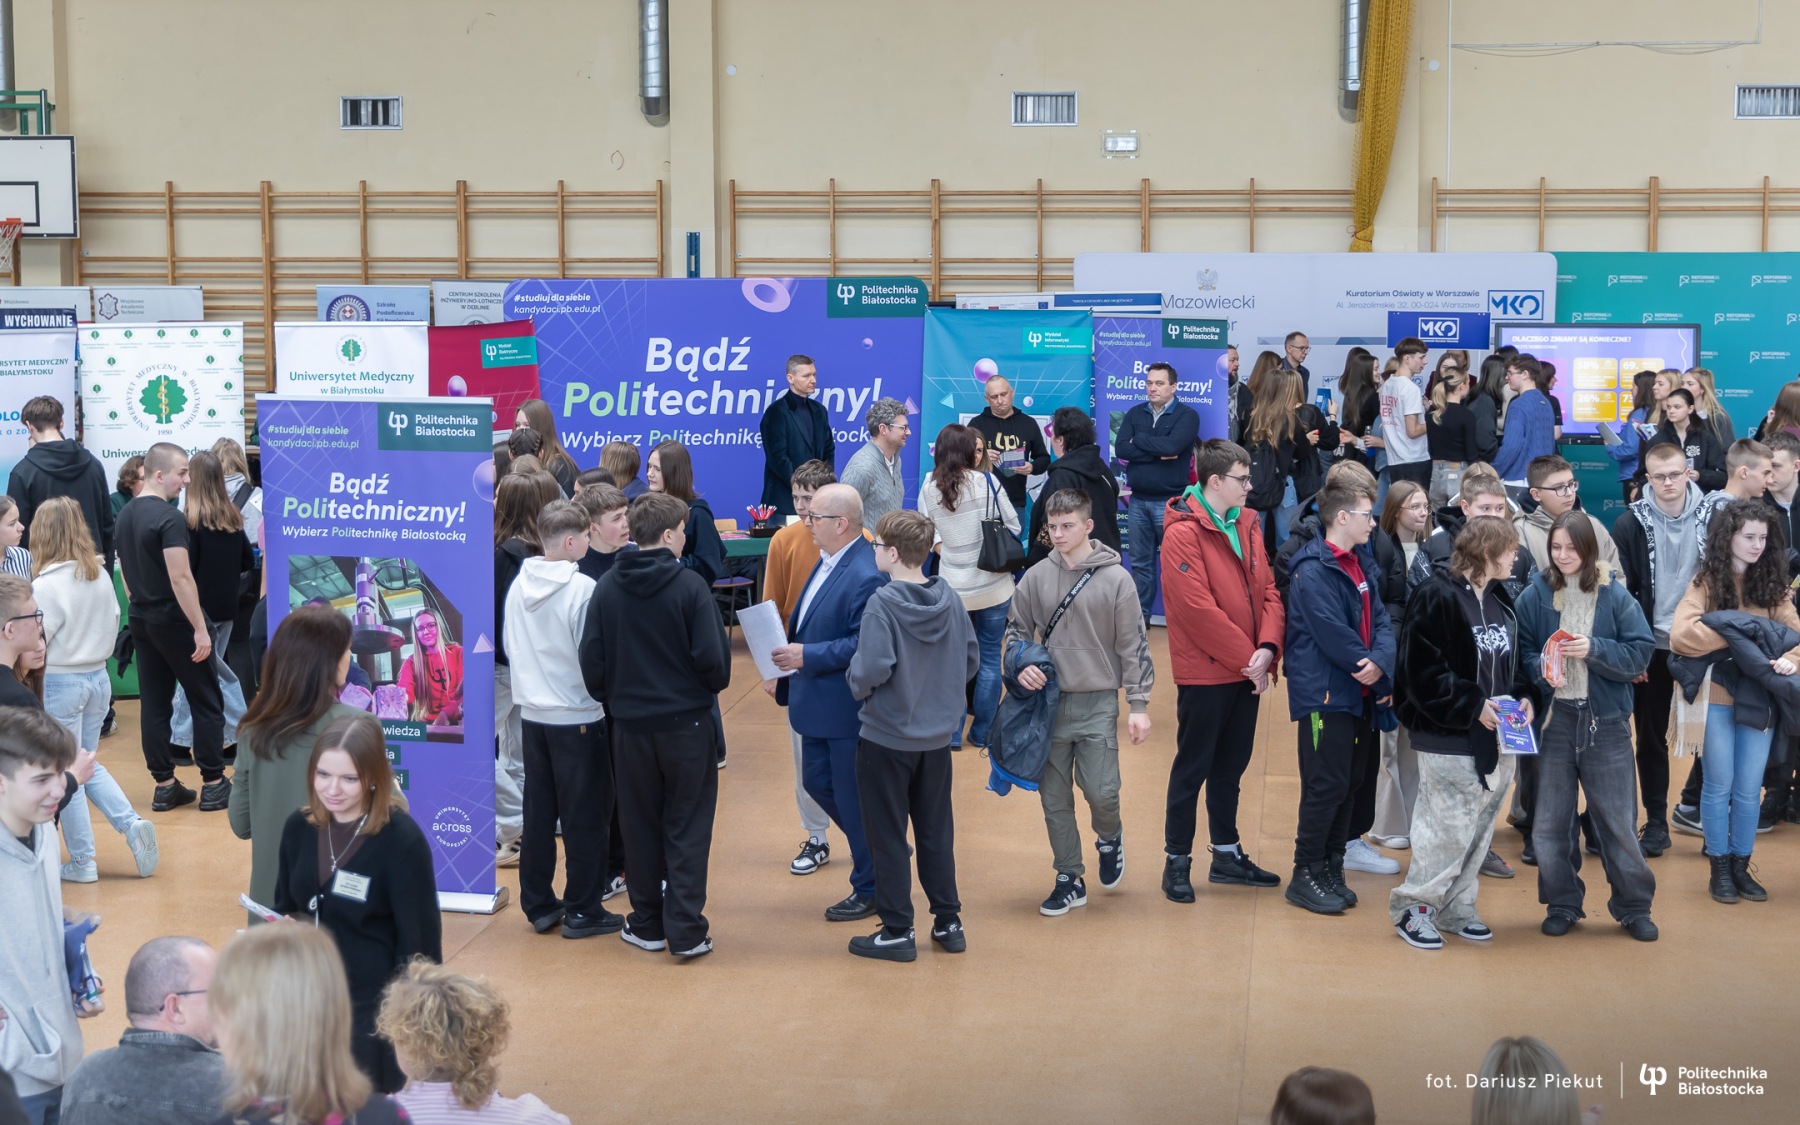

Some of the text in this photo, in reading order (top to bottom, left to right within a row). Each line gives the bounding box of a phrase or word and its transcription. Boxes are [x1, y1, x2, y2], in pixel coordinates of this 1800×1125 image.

[862, 285, 919, 296] Politechnika
[1392, 289, 1424, 299] Oświaty
[565, 292, 591, 302] siebie
[862, 295, 917, 305] Białostocka
[1161, 295, 1255, 309] Mazowiecki
[514, 304, 601, 316] kandydaci.pb.edu.pl
[1491, 295, 1541, 316] MKO
[4, 315, 73, 327] WYCHOWANIE
[1421, 321, 1457, 336] MKO
[1579, 336, 1588, 344] SĄ
[28, 358, 69, 366] MEDYCZNY
[646, 336, 752, 382] Bądź
[0, 368, 54, 376] BIAŁYMSTOKU
[136, 363, 179, 380] MEDYCZNY
[290, 371, 414, 384] Uniwersytet Medyczny
[330, 386, 384, 396] Białymstoku
[1106, 376, 1212, 395] Politeczny!
[1106, 393, 1133, 401] Wybierz
[1177, 396, 1212, 405] iałostocką
[415, 414, 478, 426] Politechnika
[268, 425, 306, 437] #studiuj
[322, 426, 349, 435] siebie
[415, 426, 476, 437] Białostocka
[268, 438, 359, 450] kandydaci.pb.edu.pl
[562, 428, 762, 452] Wybierz Politechnikę
[102, 449, 148, 458] Uniwers
[329, 472, 390, 500] Bądź
[283, 496, 466, 528] Politechniczny!
[282, 526, 466, 544] Wybierz Politechnikę Białostocką
[1070, 573, 1091, 595] Reebok
[382, 724, 421, 737] wiedza
[434, 806, 470, 821] UNIWERSYTET
[432, 822, 472, 833] across
[436, 835, 468, 847] EUROPEJSKI
